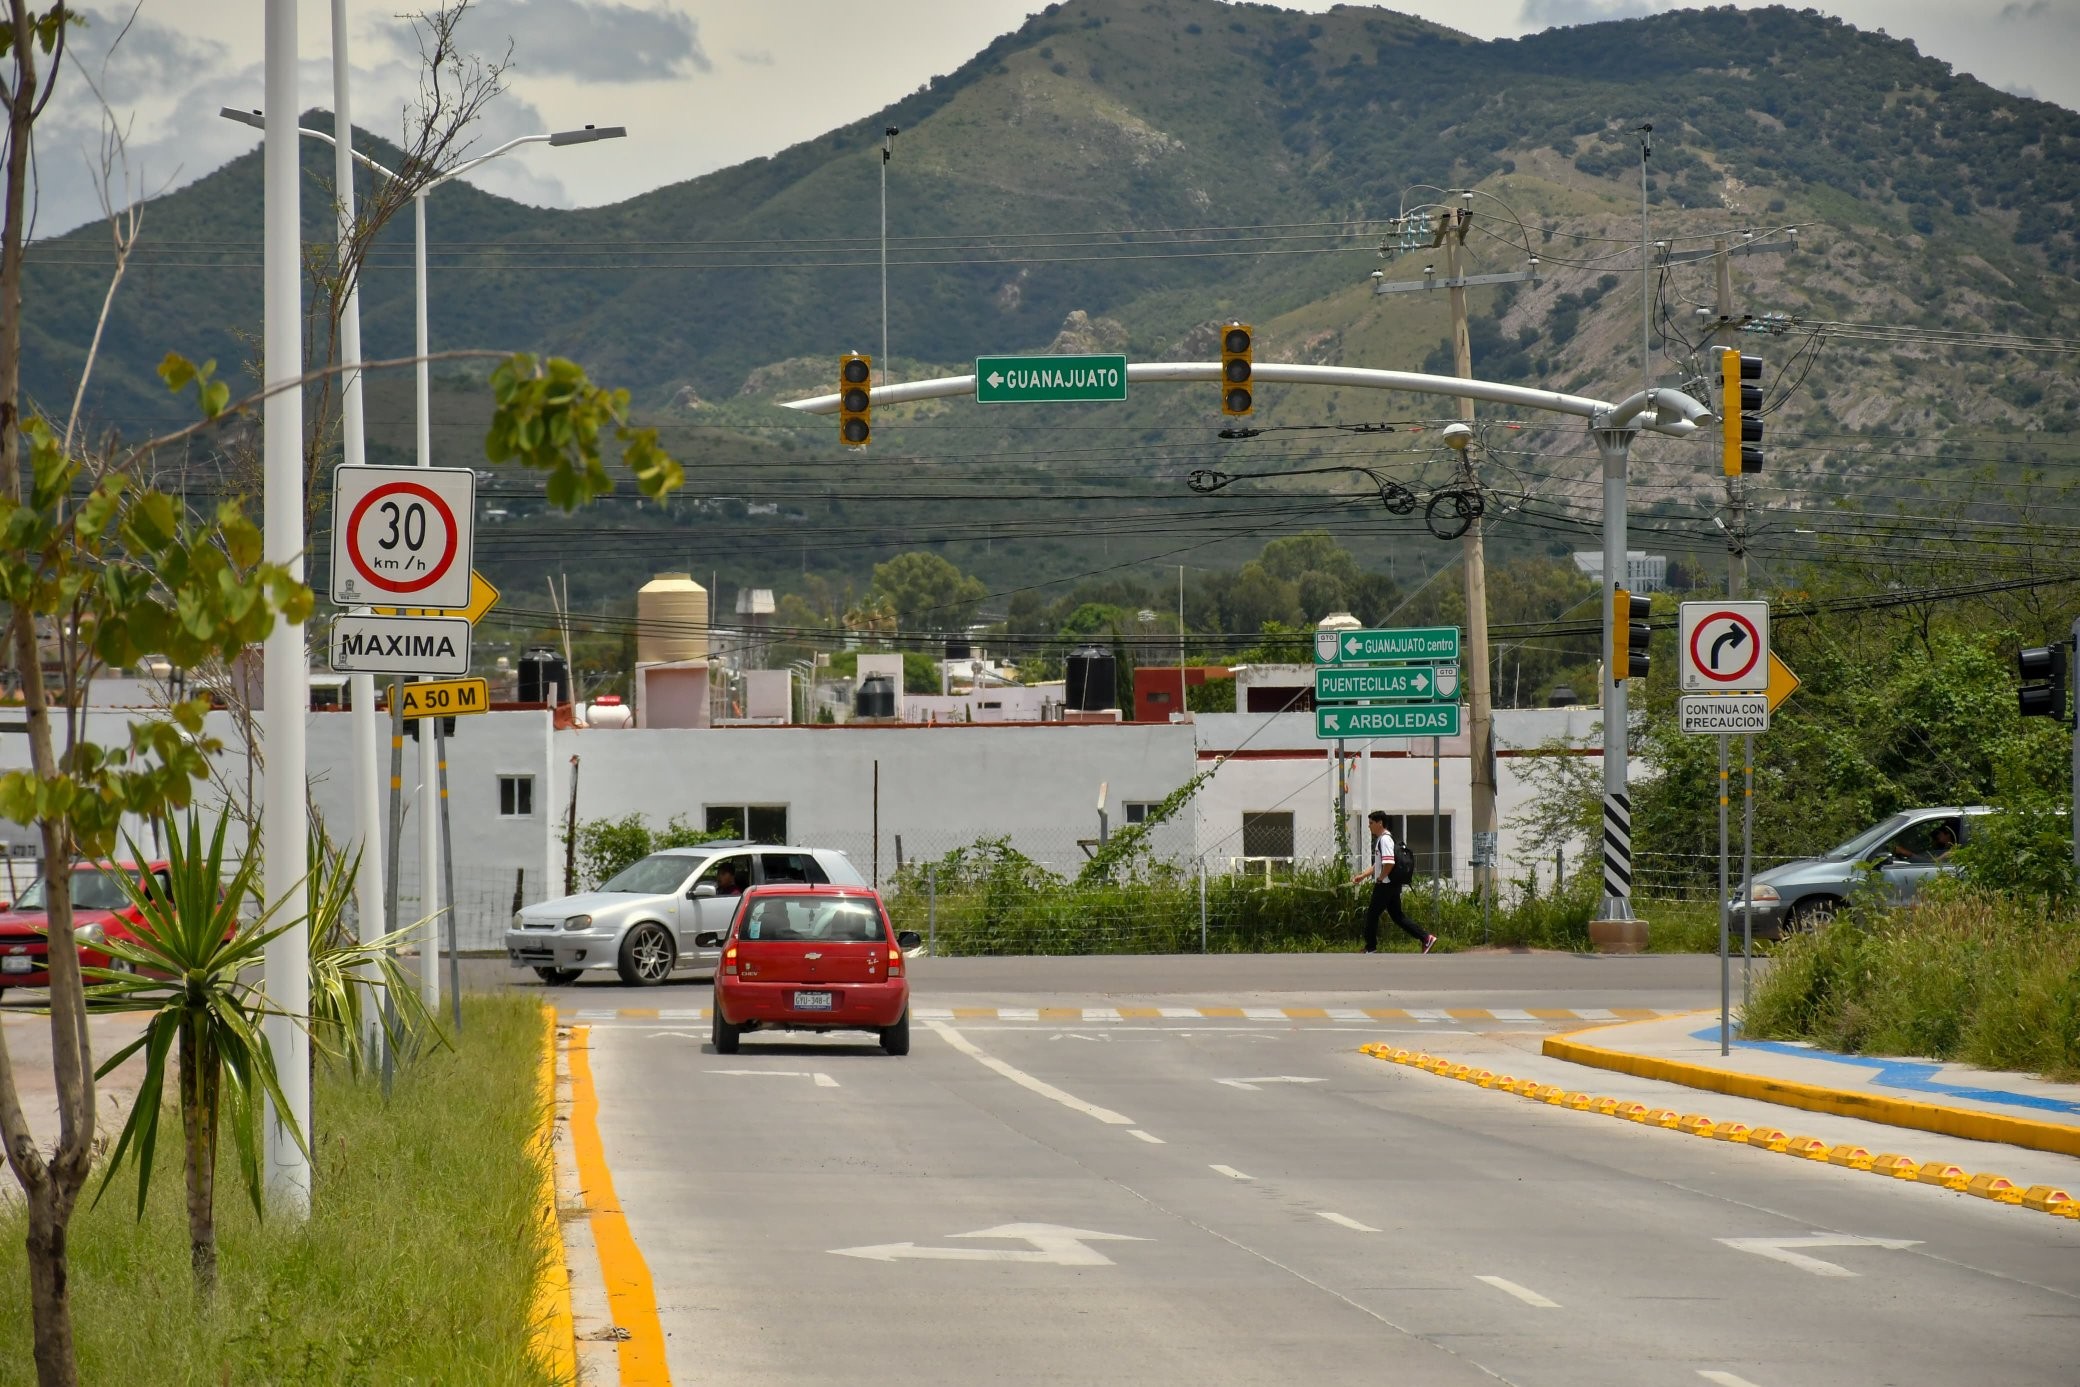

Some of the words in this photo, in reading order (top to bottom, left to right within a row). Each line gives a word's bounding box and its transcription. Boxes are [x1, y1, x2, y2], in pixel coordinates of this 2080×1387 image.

[1006, 368, 1118, 389] GUANAJUATO
[378, 501, 426, 551] 30
[374, 555, 426, 571] km/h
[342, 634, 456, 658] MAXIMA
[1365, 637, 1425, 654] GUANAJUATO
[1427, 638, 1454, 652] centro
[1322, 676, 1407, 692] PUENTECILLAS
[403, 692, 418, 710] A
[425, 689, 450, 709] 50
[457, 687, 476, 706] M
[1686, 704, 1740, 715] CONTINUA
[1742, 703, 1764, 715] CON
[1349, 713, 1448, 729] ARBOLEDAS
[1686, 717, 1764, 728] PRECAUCION
